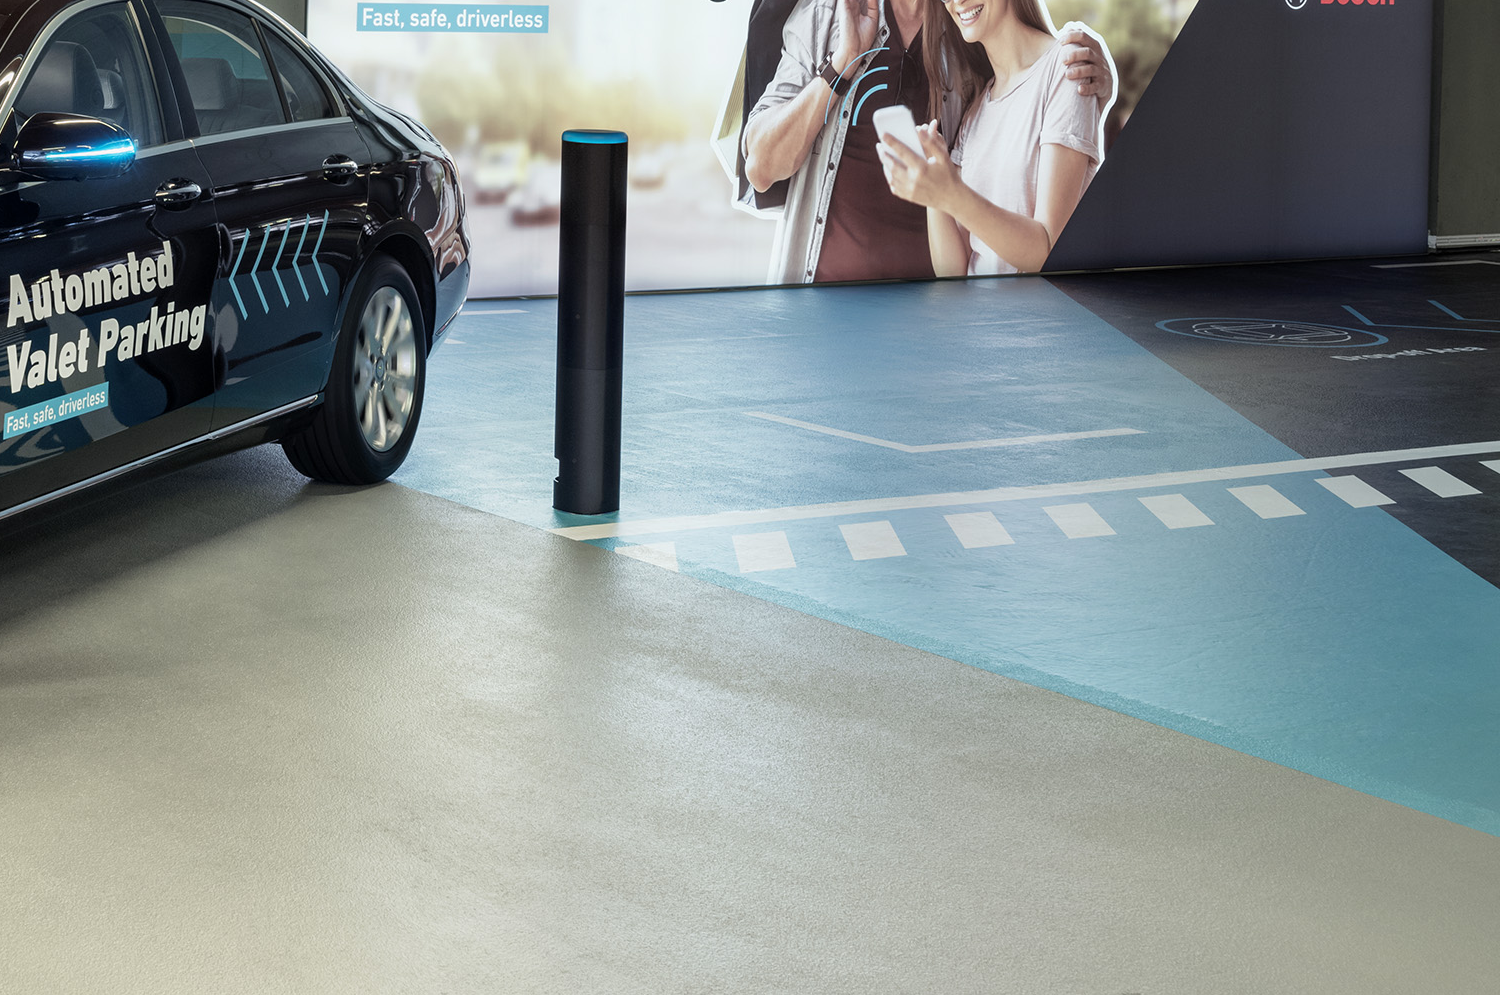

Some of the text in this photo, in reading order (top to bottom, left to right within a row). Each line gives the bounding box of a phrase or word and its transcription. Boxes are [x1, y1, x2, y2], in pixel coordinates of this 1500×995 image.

[362, 7, 543, 29] Fast, safe, driverless
[6, 240, 174, 328] Automated
[6, 301, 207, 394] Valet Parking
[6, 391, 106, 434] Fast, safe, driverless
